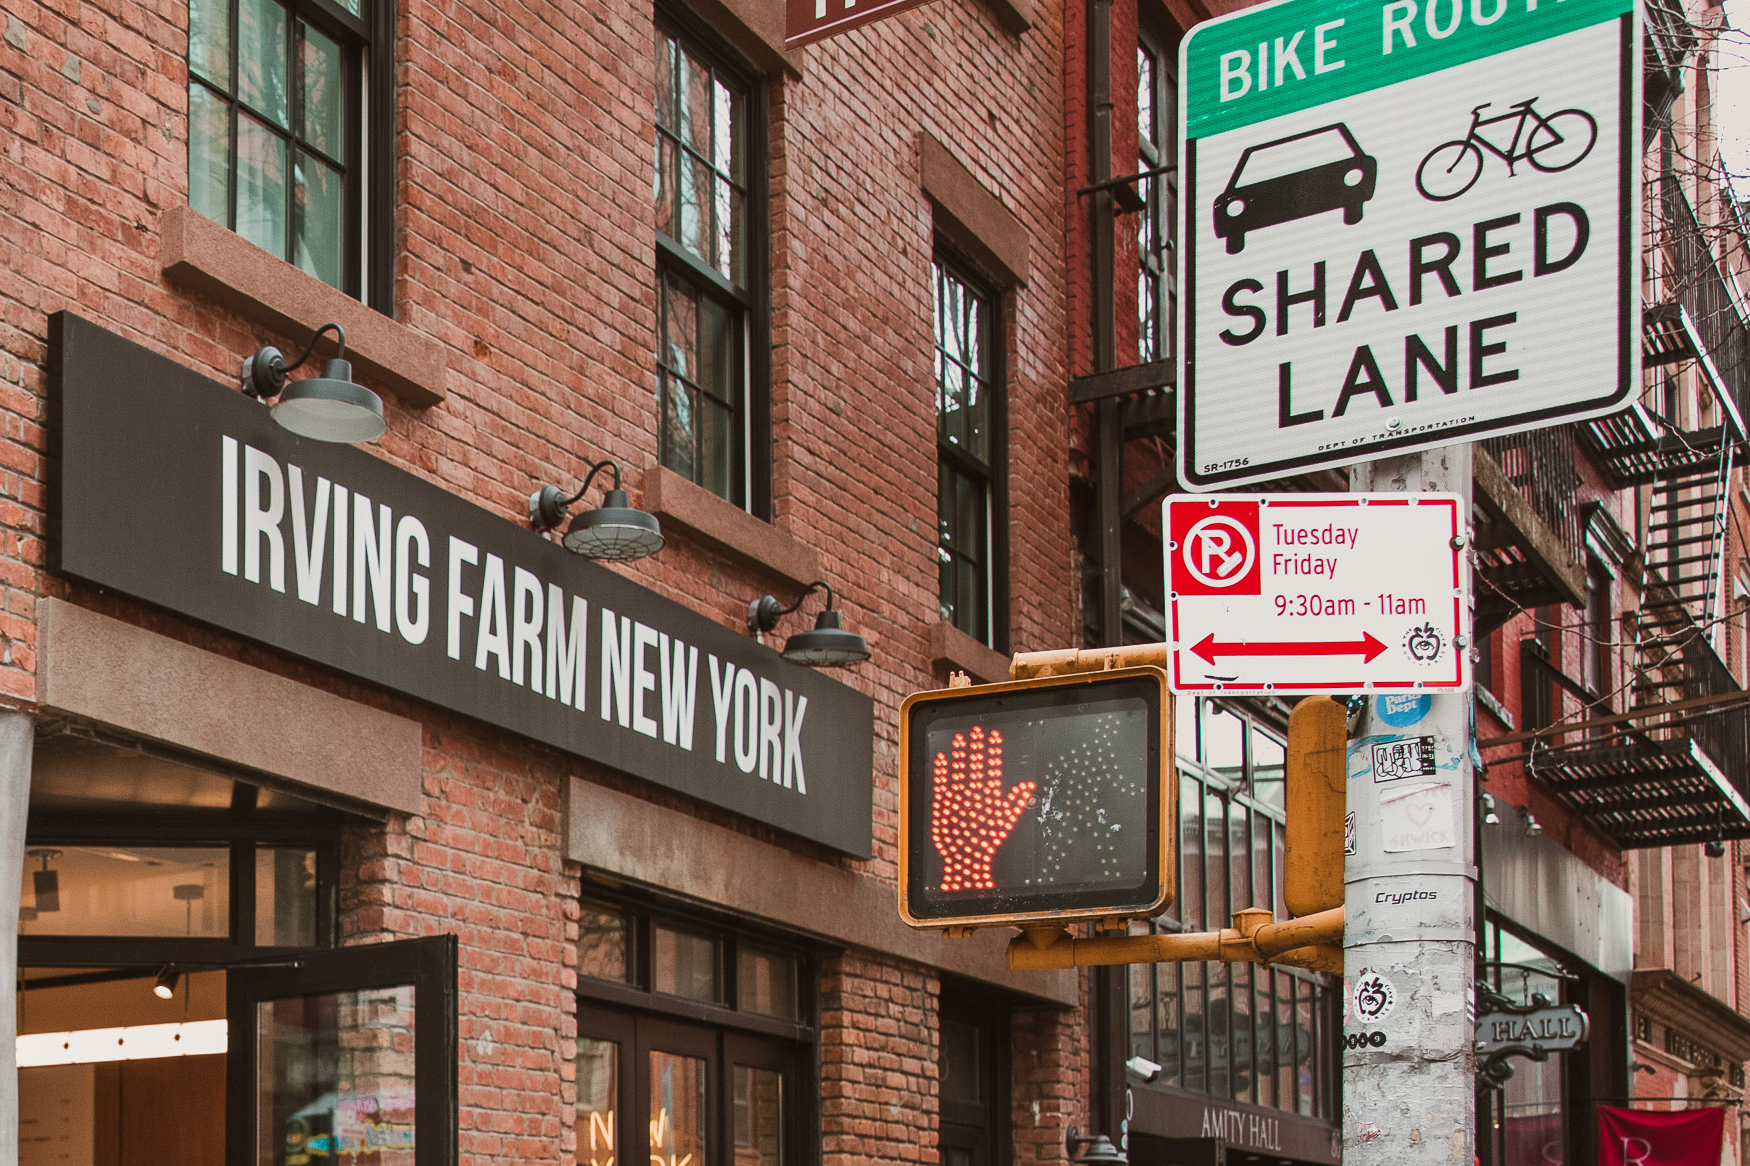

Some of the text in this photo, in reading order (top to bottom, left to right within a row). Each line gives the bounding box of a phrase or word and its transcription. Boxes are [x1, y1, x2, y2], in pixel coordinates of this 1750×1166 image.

[1218, 0, 1568, 104] BIKE ROU
[1218, 201, 1591, 348] SHARED
[1278, 311, 1520, 429] LANE
[1317, 415, 1476, 452] DEPT OF TRANSPORTATION
[1203, 457, 1250, 474] SR-1756
[1272, 523, 1359, 551] Tuesday
[1272, 553, 1338, 580] Friday
[221, 434, 808, 796] IRVING FARM NEW YORK
[1274, 594, 1356, 617] 9:30am
[1377, 593, 1426, 616] 11am
[1386, 700, 1418, 715] Dept
[1375, 890, 1438, 905] Cryptos
[1491, 1016, 1578, 1043] HALL
[590, 1107, 667, 1151] NW
[1201, 1106, 1282, 1151] AMITY HALL
